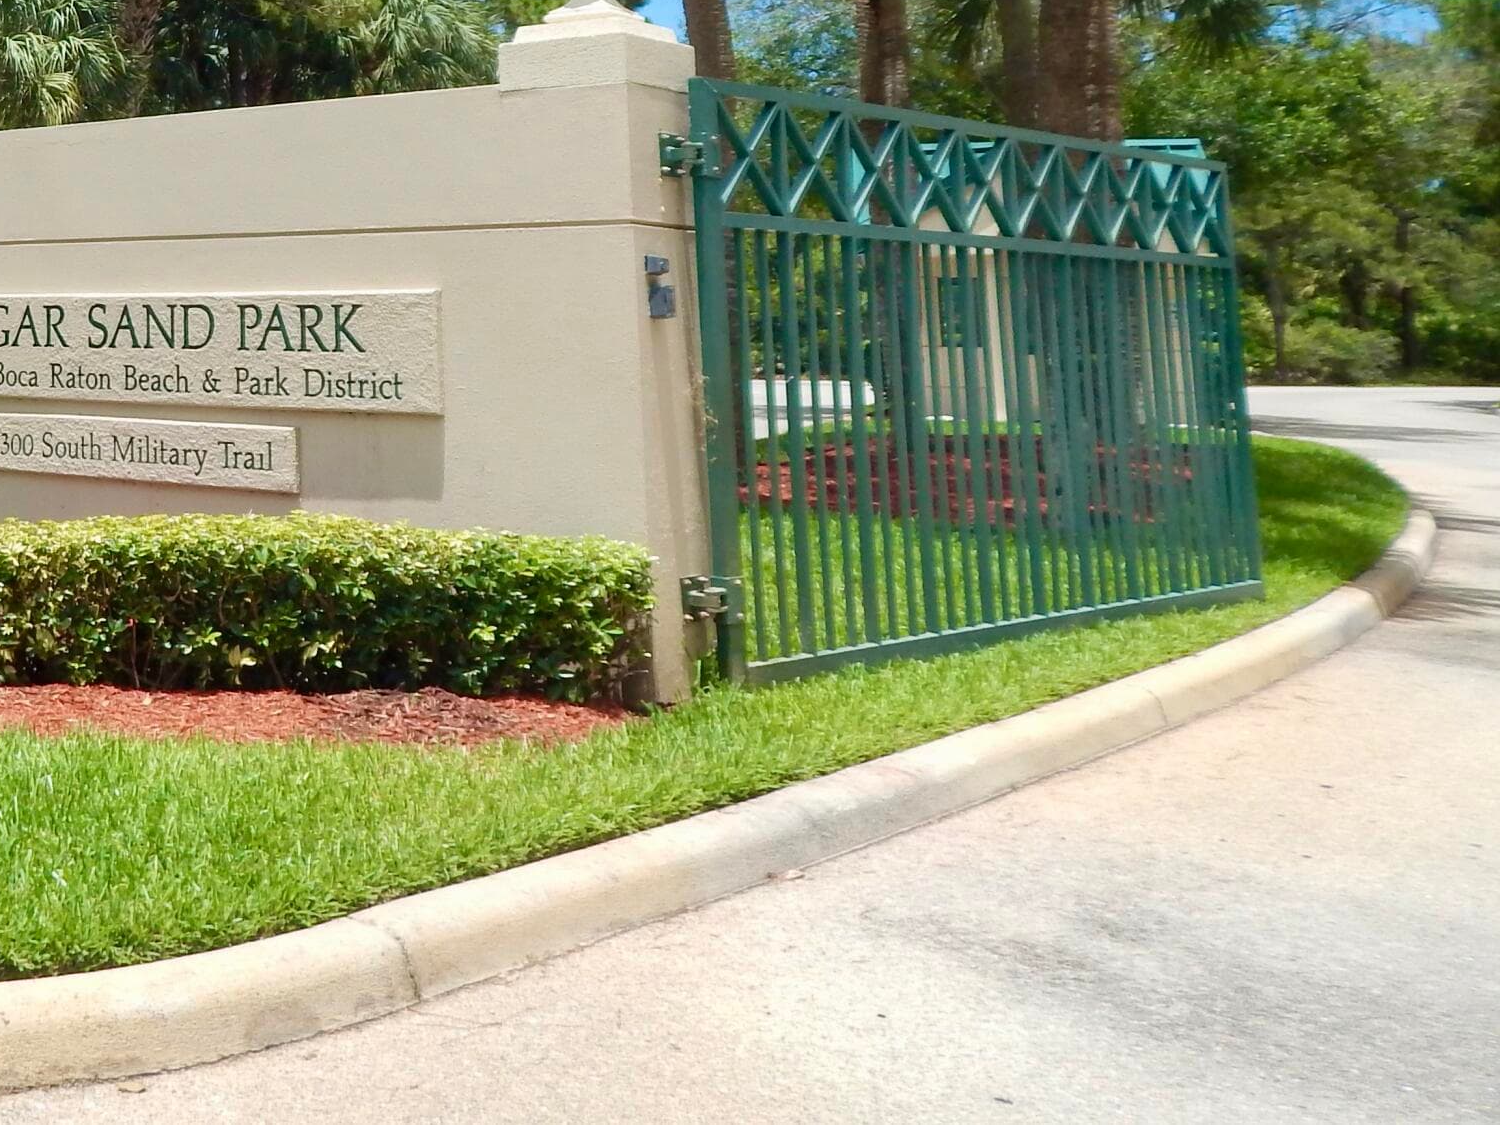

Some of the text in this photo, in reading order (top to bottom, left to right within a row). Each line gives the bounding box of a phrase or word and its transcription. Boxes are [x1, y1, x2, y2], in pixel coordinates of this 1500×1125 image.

[87, 303, 215, 350] SAND
[237, 303, 367, 353] PARK
[50, 362, 112, 390] Raton
[123, 364, 191, 394] Beach
[202, 369, 221, 394] &
[234, 367, 290, 397] Park
[302, 368, 404, 401] District
[0, 432, 274, 475] 300 South Military Trail
